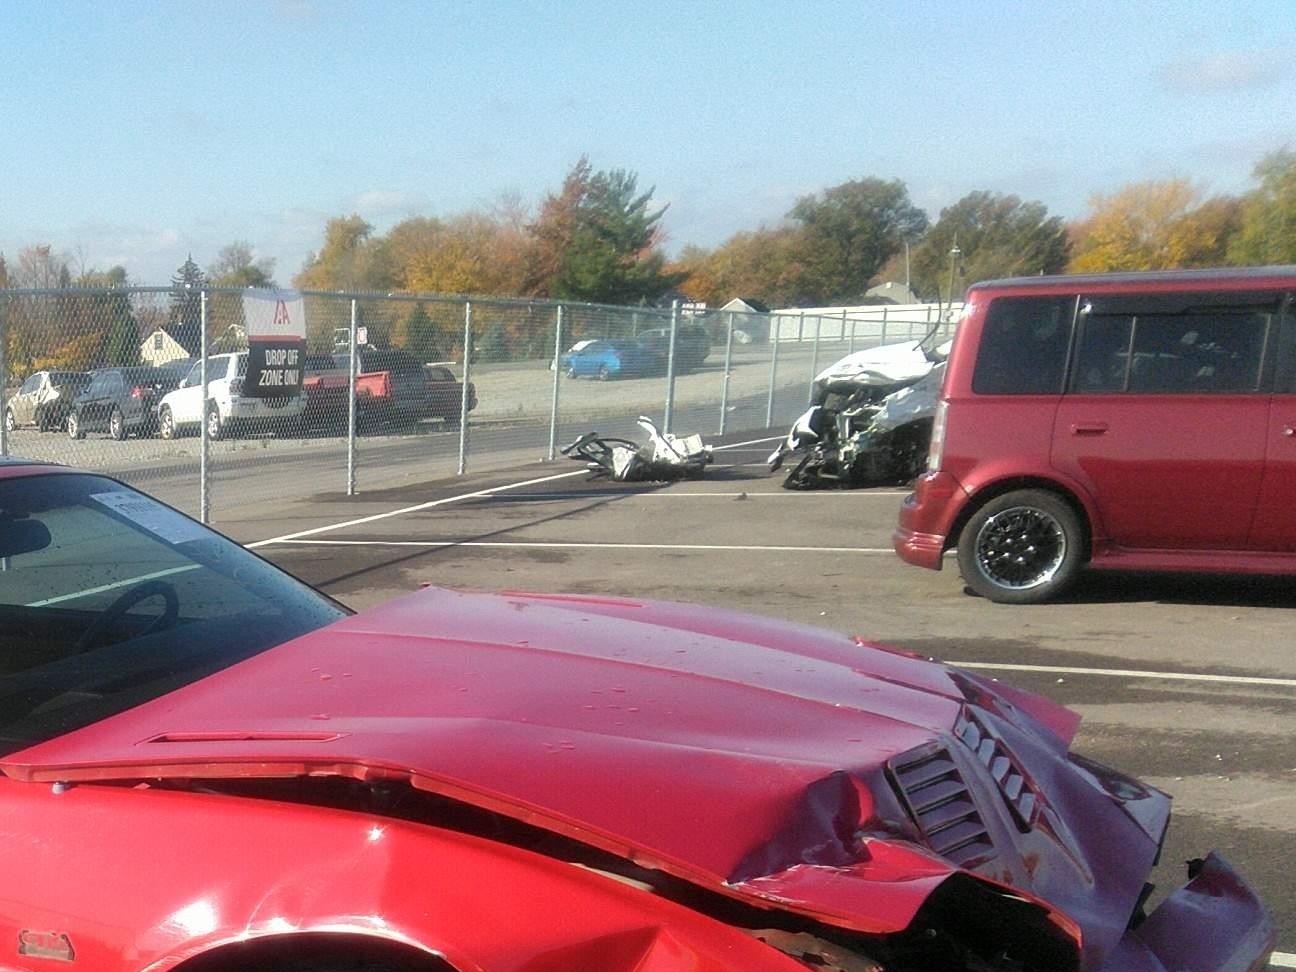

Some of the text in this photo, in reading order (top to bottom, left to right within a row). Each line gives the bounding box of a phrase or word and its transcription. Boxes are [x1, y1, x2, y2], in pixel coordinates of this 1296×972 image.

[265, 349, 300, 366] DROP OFF
[259, 369, 284, 386] ZONE
